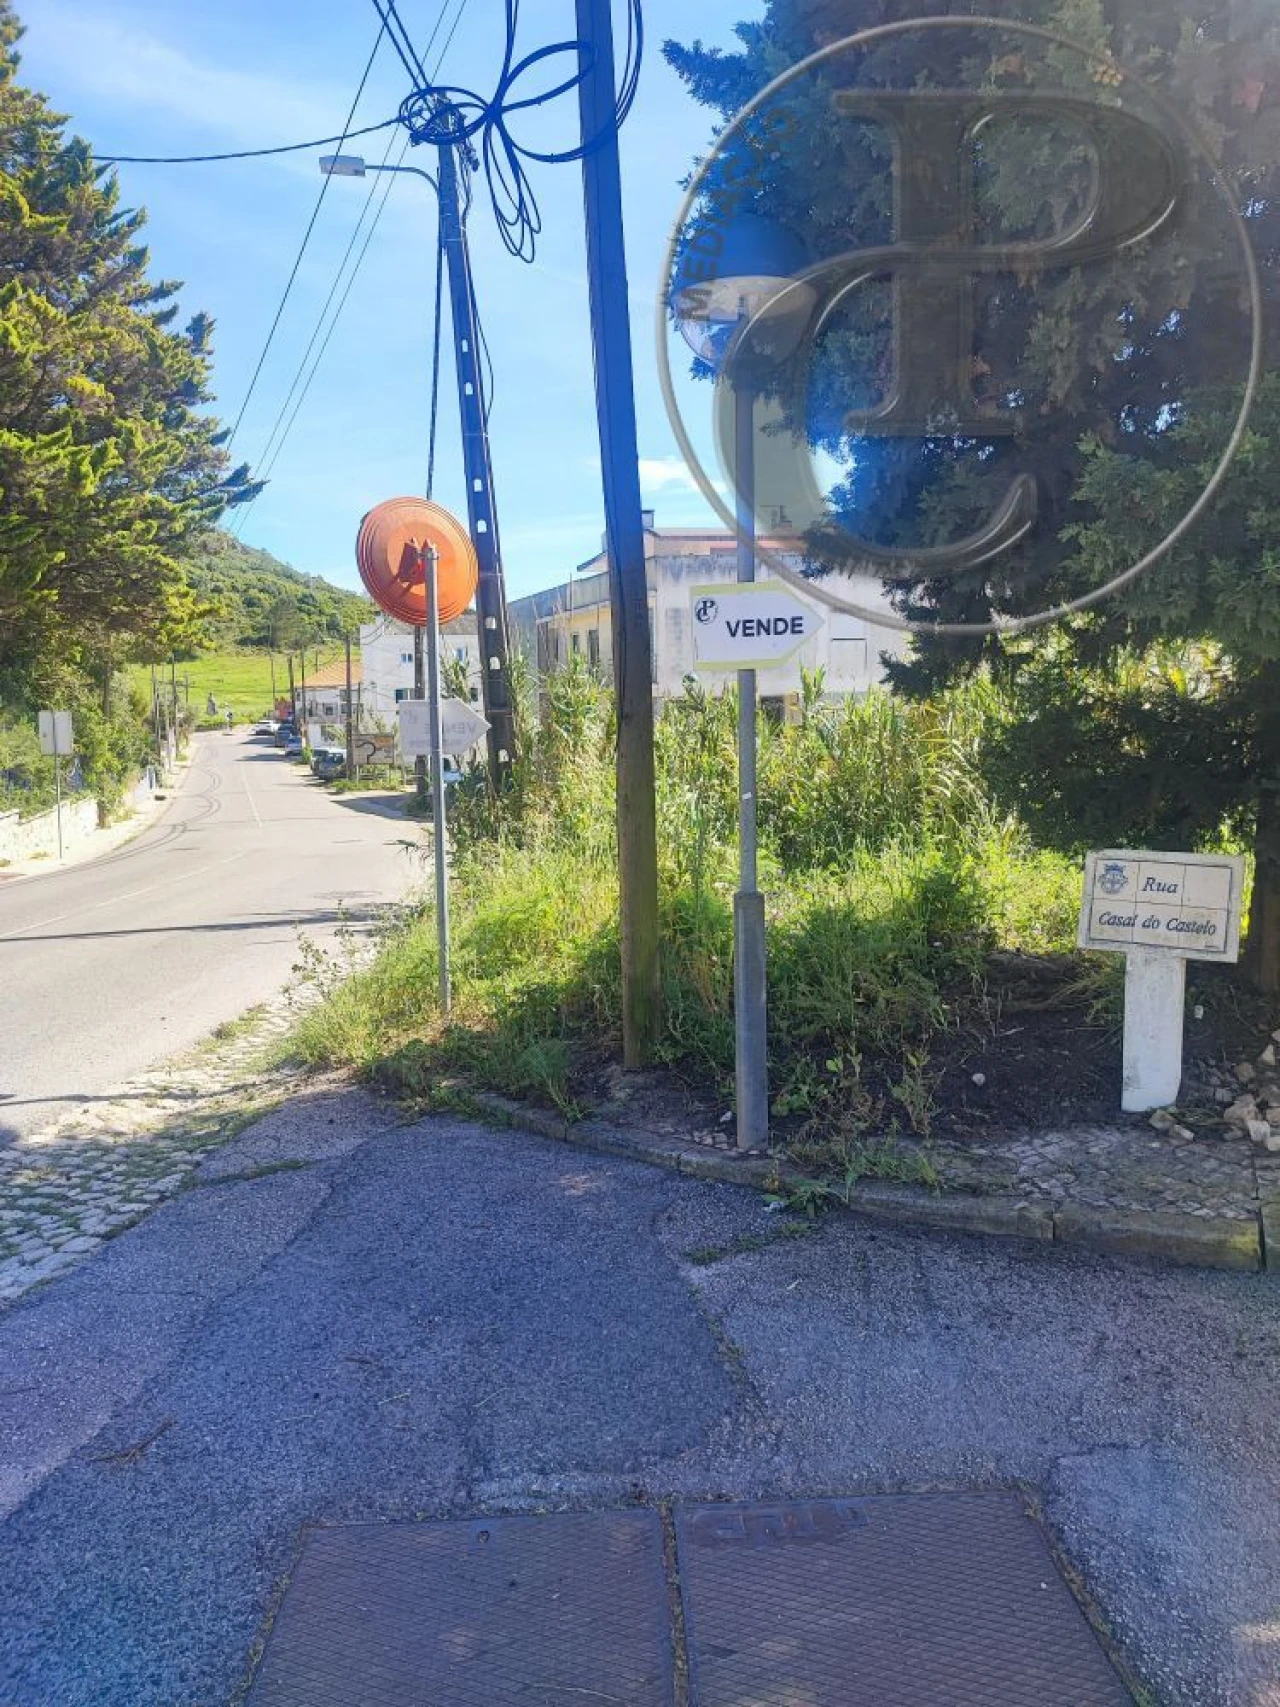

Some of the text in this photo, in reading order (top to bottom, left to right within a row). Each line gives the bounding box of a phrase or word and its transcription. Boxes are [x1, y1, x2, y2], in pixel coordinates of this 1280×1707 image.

[726, 616, 804, 638] VENDE
[1142, 877, 1178, 894] Rua
[1099, 912, 1217, 936] Casal do Castelo
